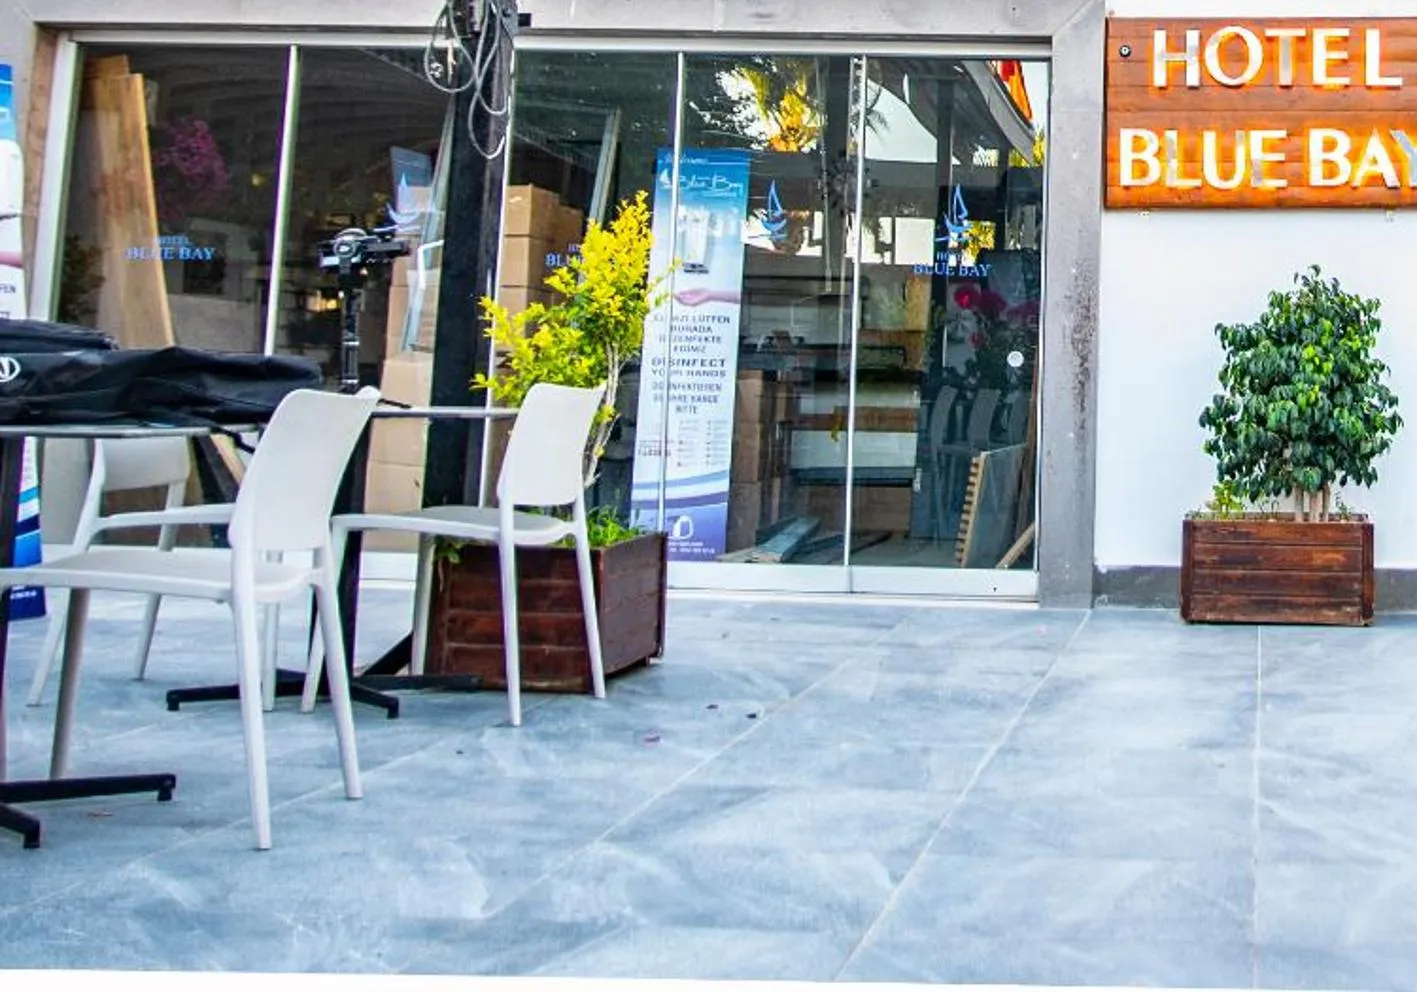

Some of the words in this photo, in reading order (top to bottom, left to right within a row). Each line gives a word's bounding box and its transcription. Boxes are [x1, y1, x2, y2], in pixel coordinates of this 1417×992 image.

[1151, 26, 1404, 89] HOTEL
[1118, 127, 1289, 190] BLUE
[179, 247, 215, 261] BAY
[913, 262, 955, 276] BLUE
[958, 264, 993, 277] BAY
